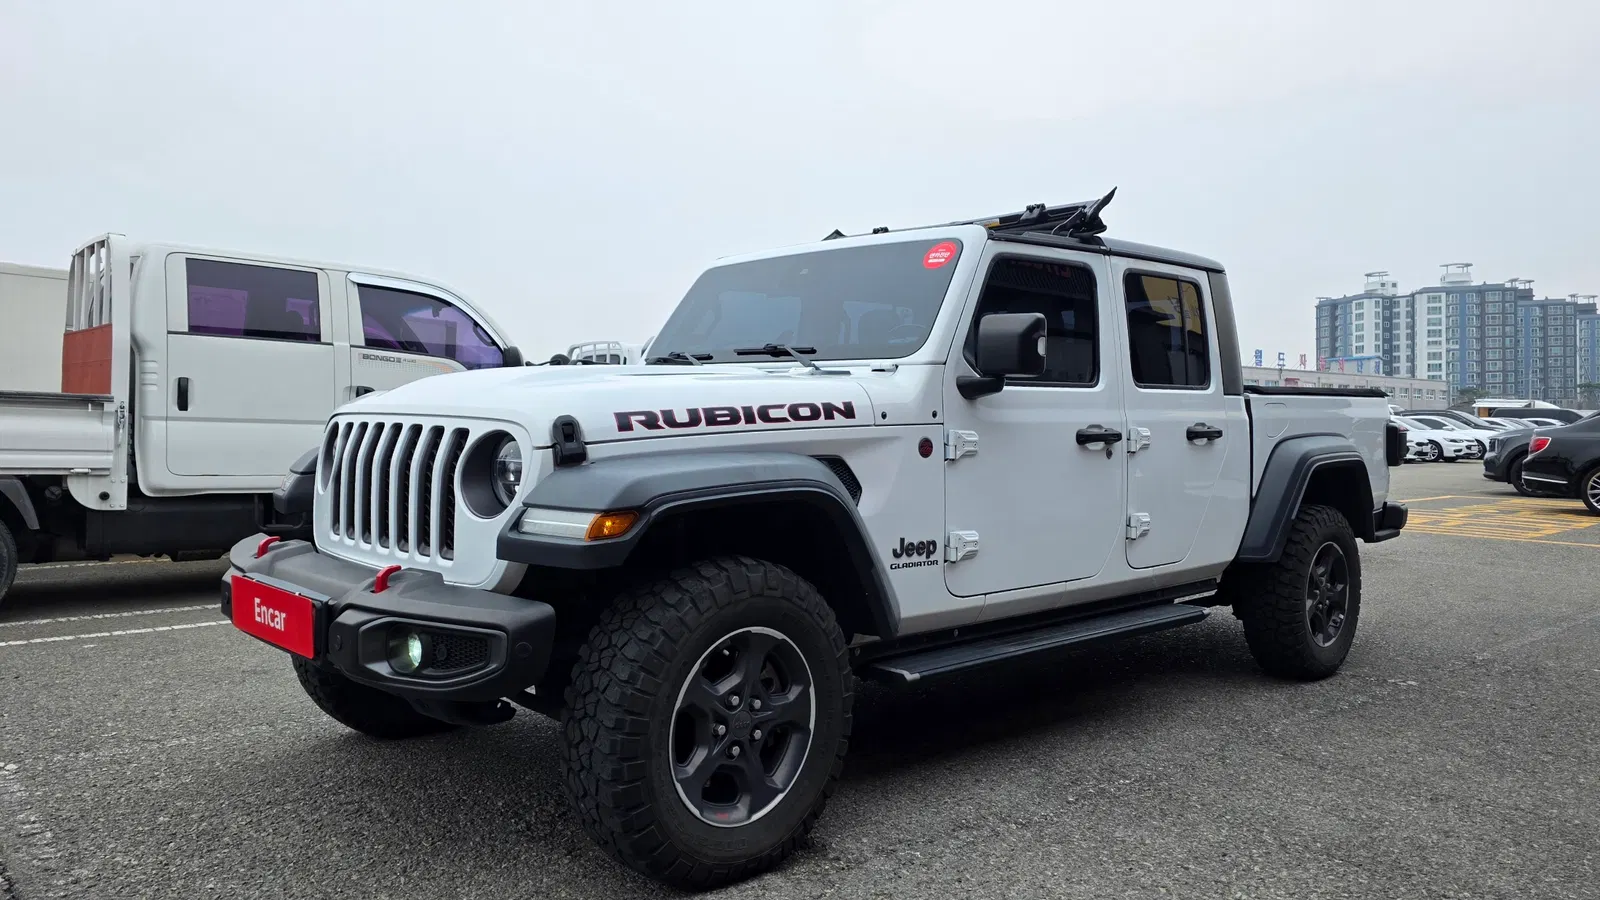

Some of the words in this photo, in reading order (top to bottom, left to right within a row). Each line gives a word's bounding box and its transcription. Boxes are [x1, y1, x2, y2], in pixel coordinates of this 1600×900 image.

[362, 353, 395, 363] BONGO
[613, 401, 857, 433] RUBICON
[892, 536, 937, 559] Jeep
[890, 559, 939, 570] GLADIATOR
[254, 597, 287, 632] Encar
